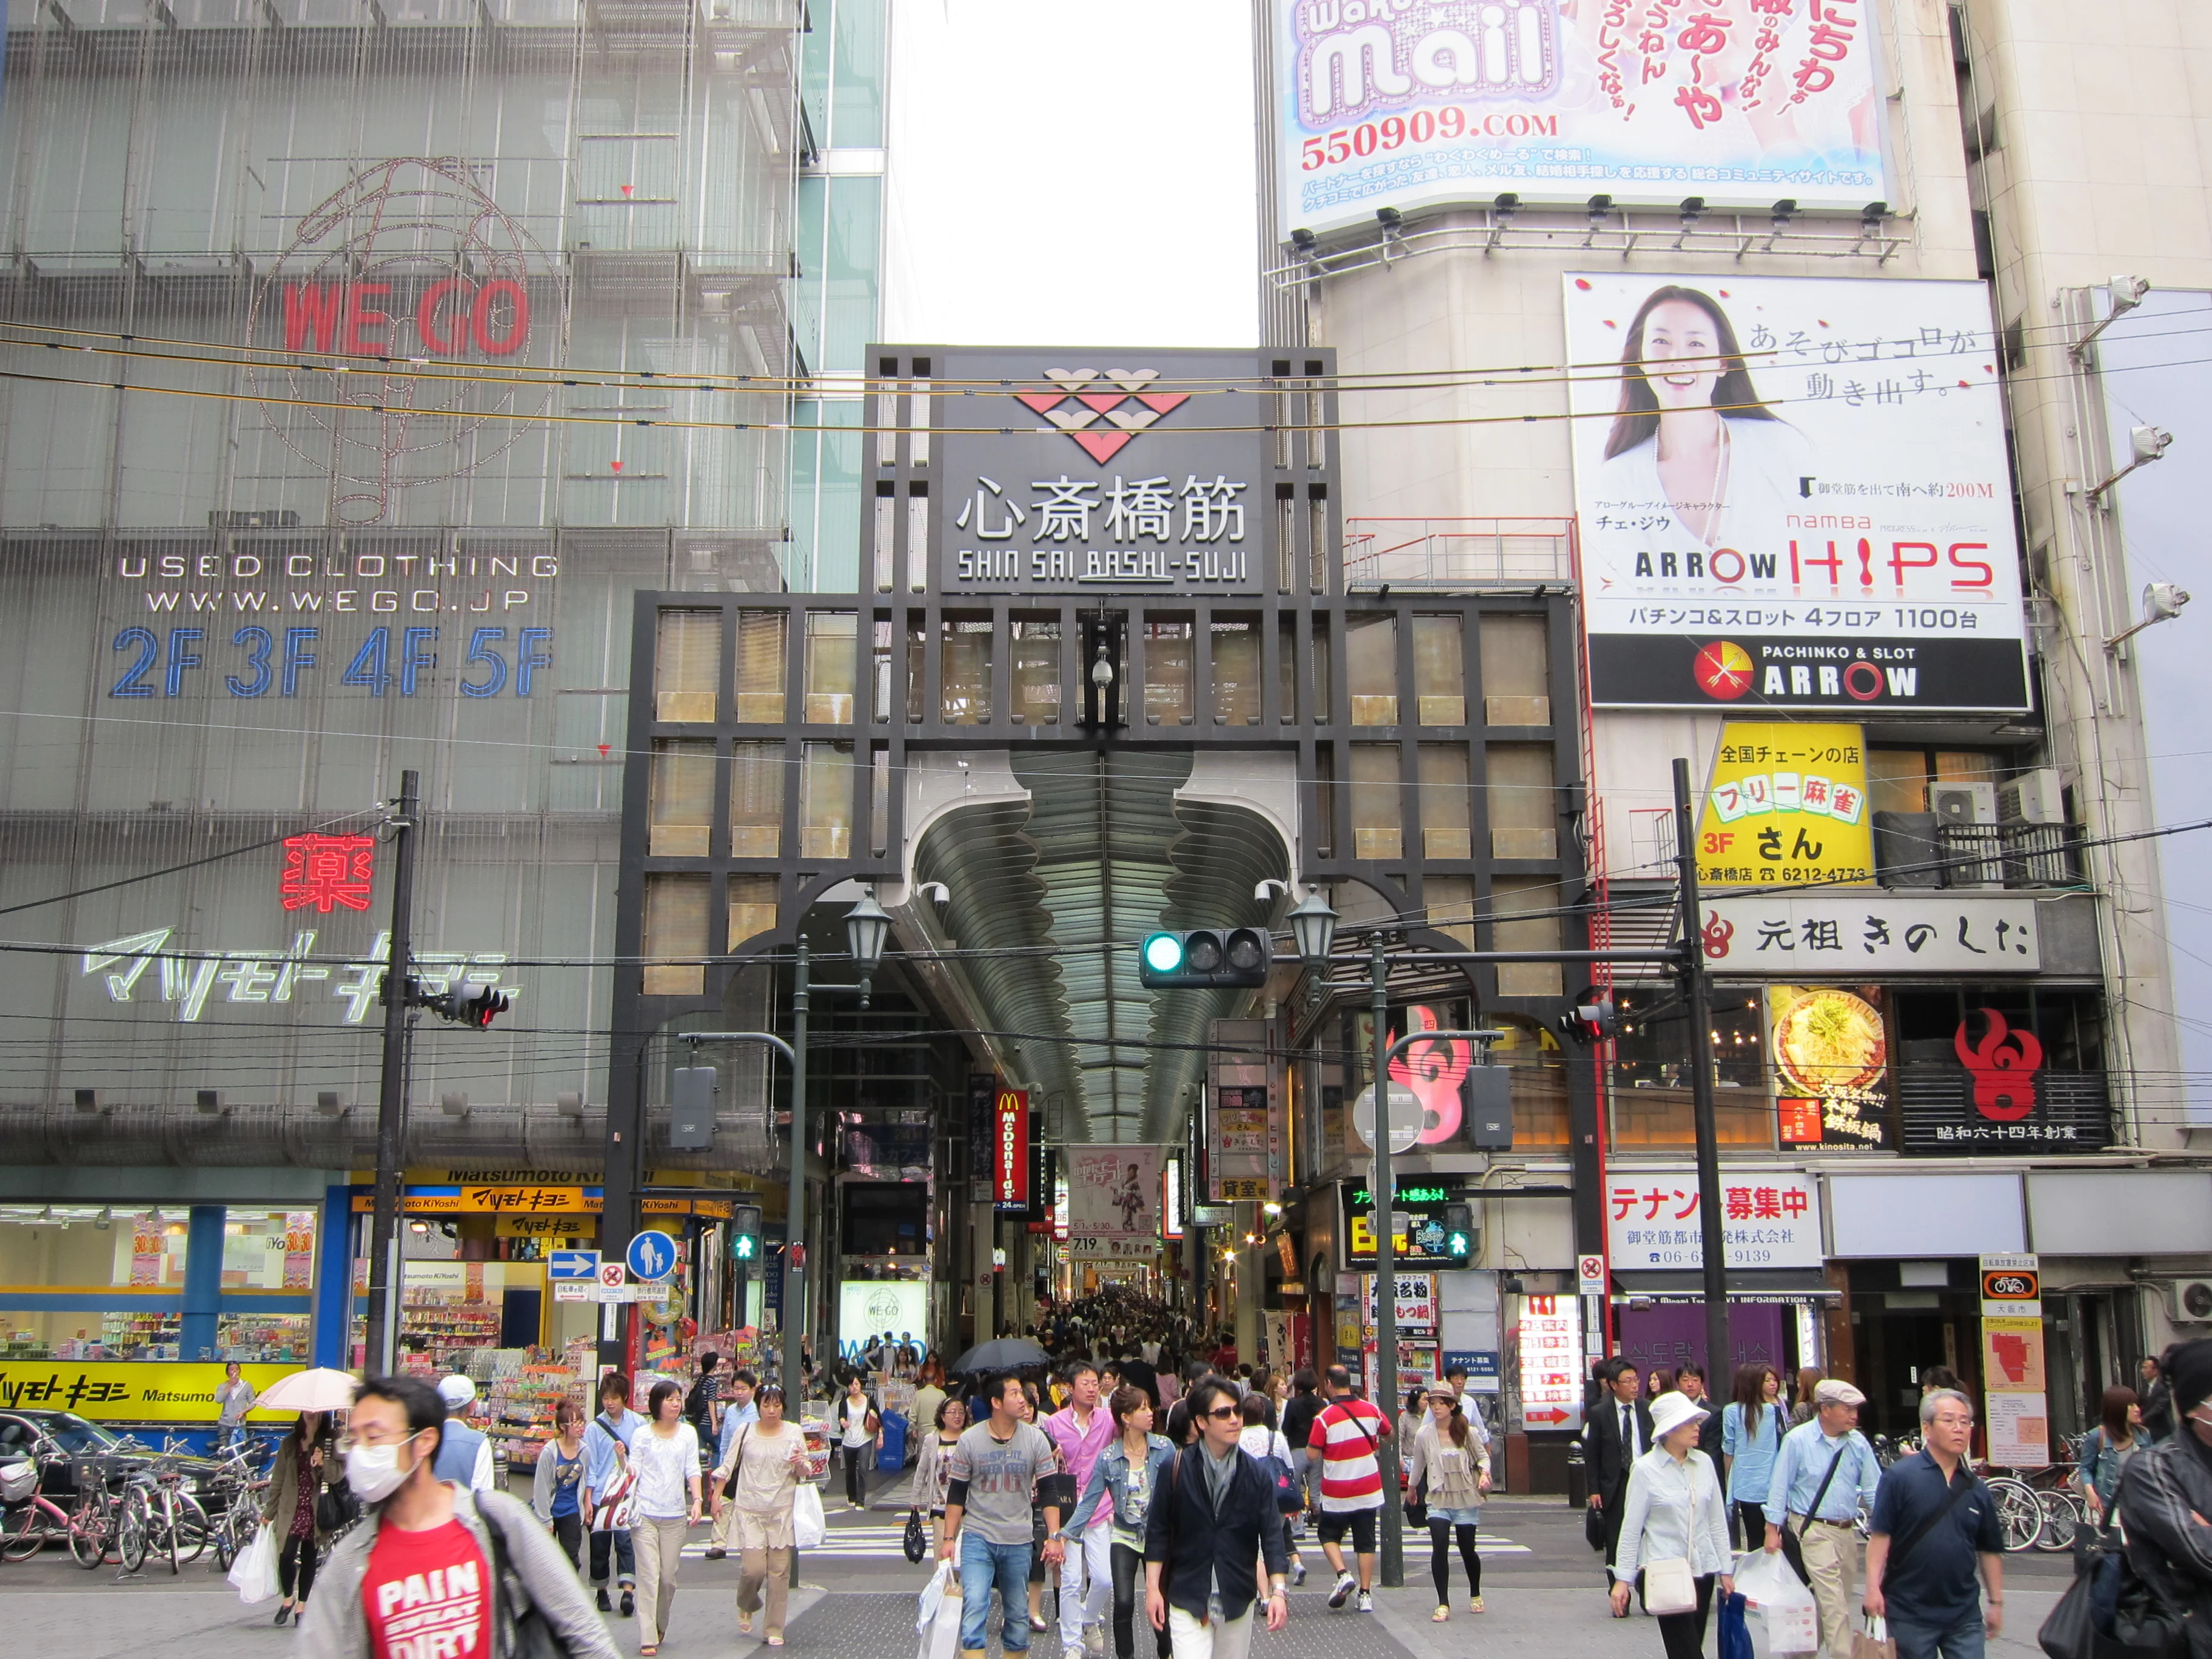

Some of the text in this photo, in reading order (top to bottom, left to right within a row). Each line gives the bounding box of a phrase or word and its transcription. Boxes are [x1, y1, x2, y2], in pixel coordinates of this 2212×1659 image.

[1309, 4, 1545, 117] mail
[1301, 106, 1560, 172] 550909.COM
[1750, 323, 1977, 365] あそびゴコロが
[1805, 367, 1948, 407] 動き出す。
[956, 474, 1248, 545] 心斎橋筋
[1595, 515, 1671, 532] チェ・ジウ
[122, 555, 559, 577] USED CLOTHING
[958, 549, 1019, 581] SHIN
[1032, 550, 1074, 581] SAI
[1635, 547, 1777, 584] ARROW
[147, 590, 529, 612] WWW.WEGO.JP
[1894, 609, 1978, 629] 1100台
[107, 626, 555, 698] 2F 3F 4F 5F
[1762, 646, 1916, 660] PACHINKO & SLOT
[1763, 661, 1917, 700] ARROW
[1721, 745, 1859, 765] 全国チェーンの店
[1719, 775, 1858, 814] フリー麻雀
[1704, 826, 1823, 861] 3F さん
[282, 833, 374, 912] 薬
[1697, 868, 1753, 882] 心斎橋店
[1936, 1125, 2077, 1141] 昭和六十四年創業
[423, 1199, 460, 1208] KiYoshi
[472, 1188, 571, 1211] マツモトキヨシ
[1612, 1187, 1808, 1221] テナン募集中
[512, 1218, 581, 1235] マツモトキヨシ
[1626, 1228, 1795, 1245] 御堂筋都市発株式会社
[1073, 1238, 1098, 1251] 7.19
[1663, 1250, 1771, 1263] 06-6-9139
[1629, 1339, 1694, 1366] 식도락
[377, 1560, 481, 1618] PAIN
[387, 1620, 481, 1659] DIRT
